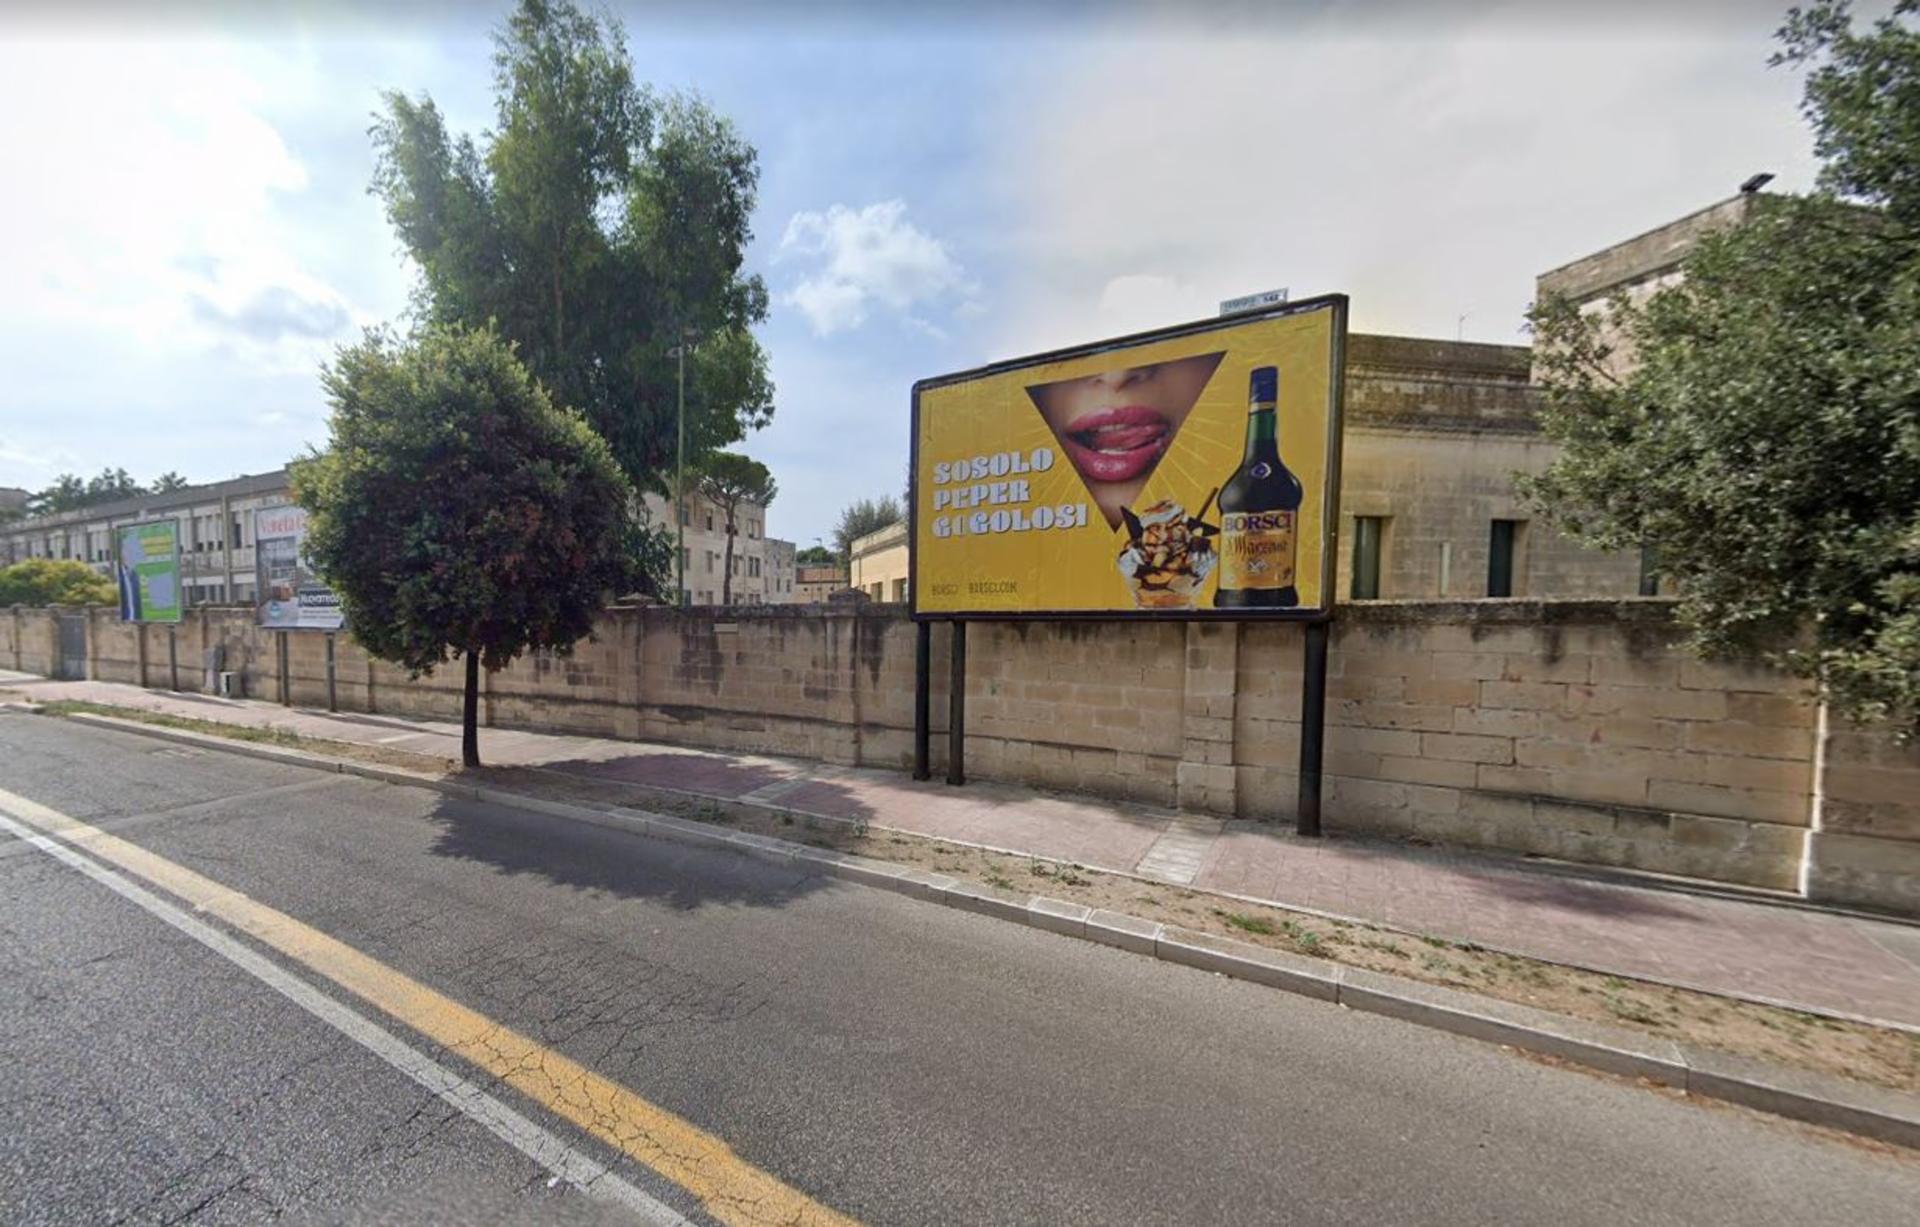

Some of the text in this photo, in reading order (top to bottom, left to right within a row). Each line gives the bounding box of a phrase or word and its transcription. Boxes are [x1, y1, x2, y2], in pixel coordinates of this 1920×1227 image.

[933, 447, 1055, 485] SOSOLO
[933, 479, 1031, 511] PEPER
[1224, 512, 1292, 532] BORSCI
